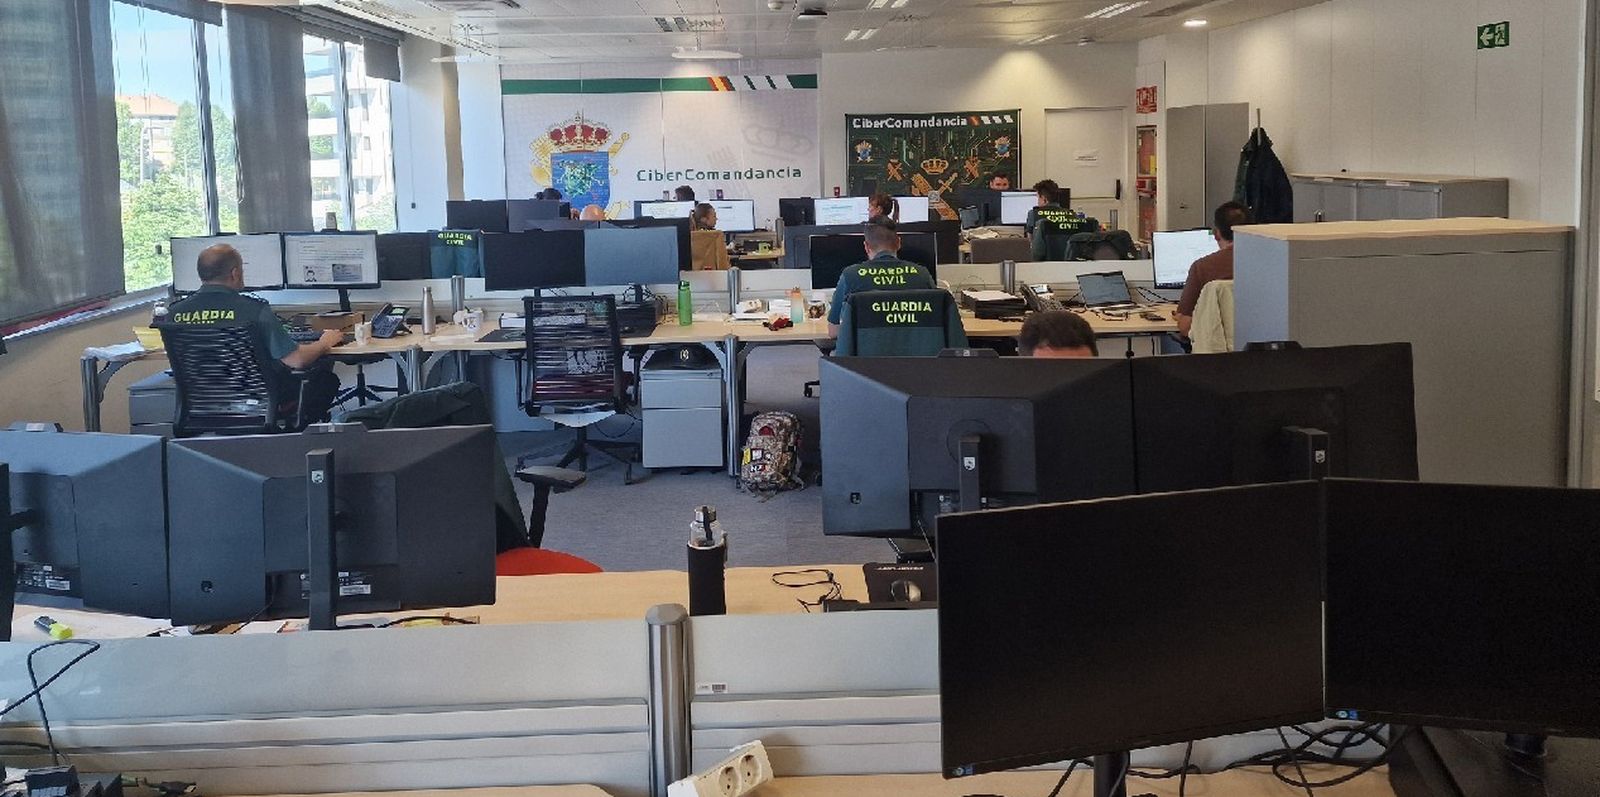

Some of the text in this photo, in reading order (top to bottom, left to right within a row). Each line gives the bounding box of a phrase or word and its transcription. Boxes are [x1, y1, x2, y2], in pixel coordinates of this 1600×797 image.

[852, 115, 968, 129] CiberComandancia
[636, 166, 802, 182] CiberComandancia
[857, 266, 919, 276] GUARDIA
[873, 275, 907, 285] CIVIL
[871, 301, 933, 313] GUARDIA
[173, 310, 235, 323] GUARDIA
[885, 313, 919, 324] CIVIL
